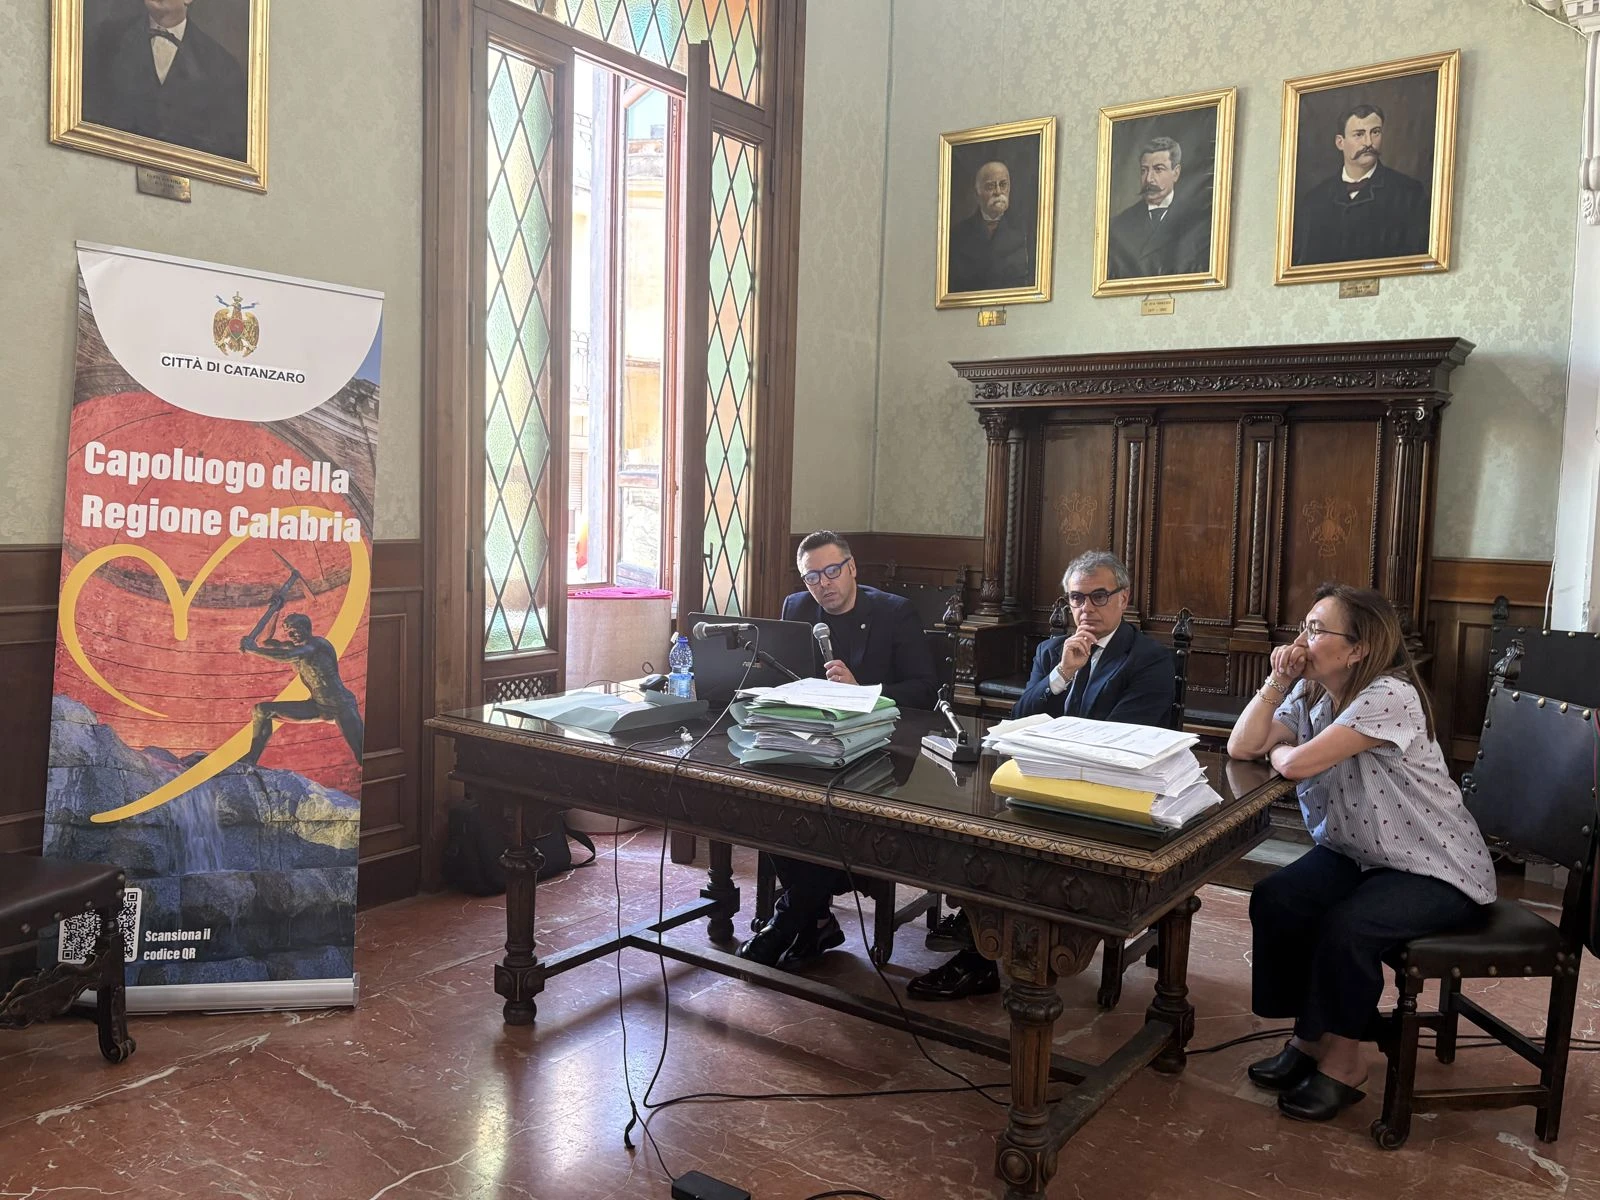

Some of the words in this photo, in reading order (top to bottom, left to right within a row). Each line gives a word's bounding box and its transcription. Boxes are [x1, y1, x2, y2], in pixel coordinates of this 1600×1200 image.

[161, 356, 203, 370] CITTÀ
[207, 361, 220, 373] DI
[223, 364, 306, 384] CATANZARO
[83, 441, 266, 494] Capoluogo
[272, 459, 350, 494] della
[81, 494, 222, 538] Regione
[229, 505, 361, 542] Calabria
[145, 929, 201, 942] Scansiona
[203, 928, 211, 940] il
[143, 948, 180, 961] codice
[182, 947, 196, 960] QR
